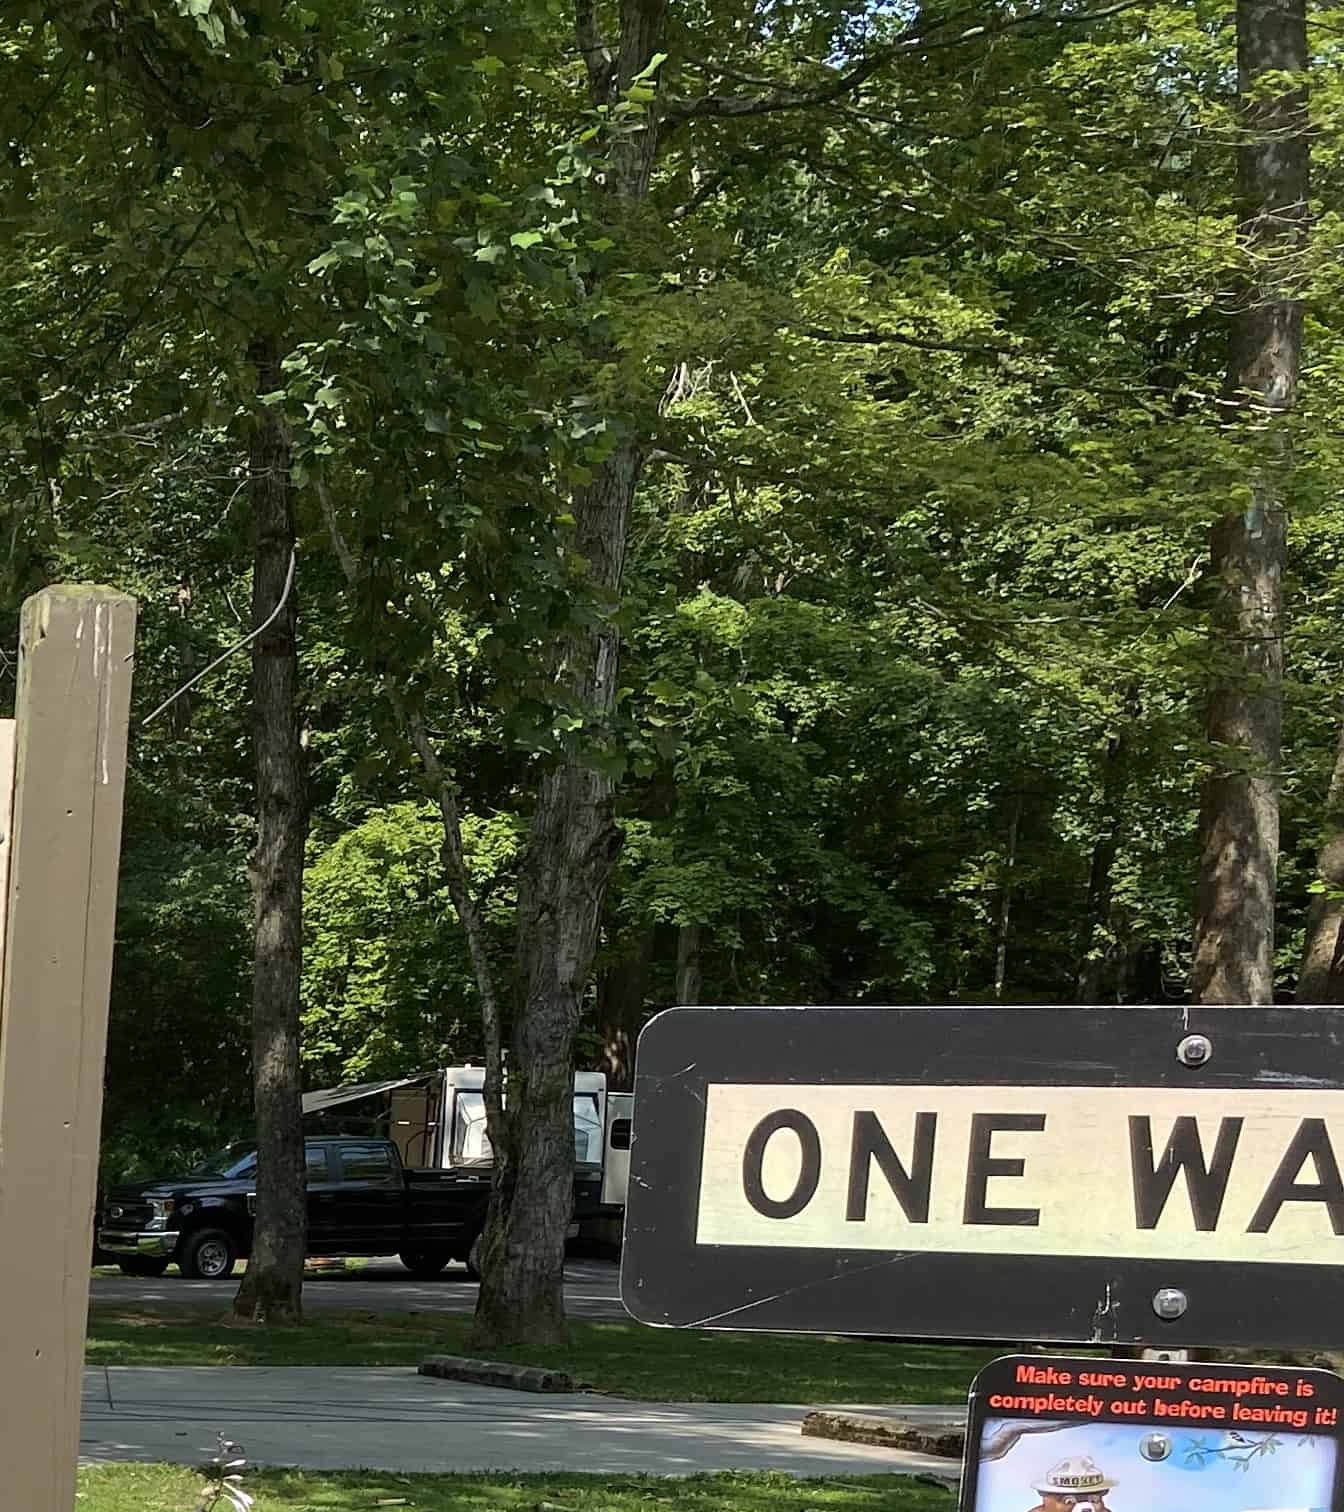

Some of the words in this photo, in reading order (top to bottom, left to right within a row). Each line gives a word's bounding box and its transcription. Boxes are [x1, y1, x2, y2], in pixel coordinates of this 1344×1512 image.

[743, 1109, 1046, 1226] ONE
[1016, 1366, 1072, 1385] Make
[1079, 1373, 1126, 1387] sure
[1135, 1376, 1182, 1390] your
[1188, 1377, 1289, 1396] campfire
[1296, 1381, 1312, 1397] is
[989, 1395, 1104, 1415] completely
[1108, 1401, 1146, 1415] out
[1153, 1400, 1226, 1418] before
[1232, 1404, 1309, 1427] leaving
[1313, 1408, 1336, 1424] it!
